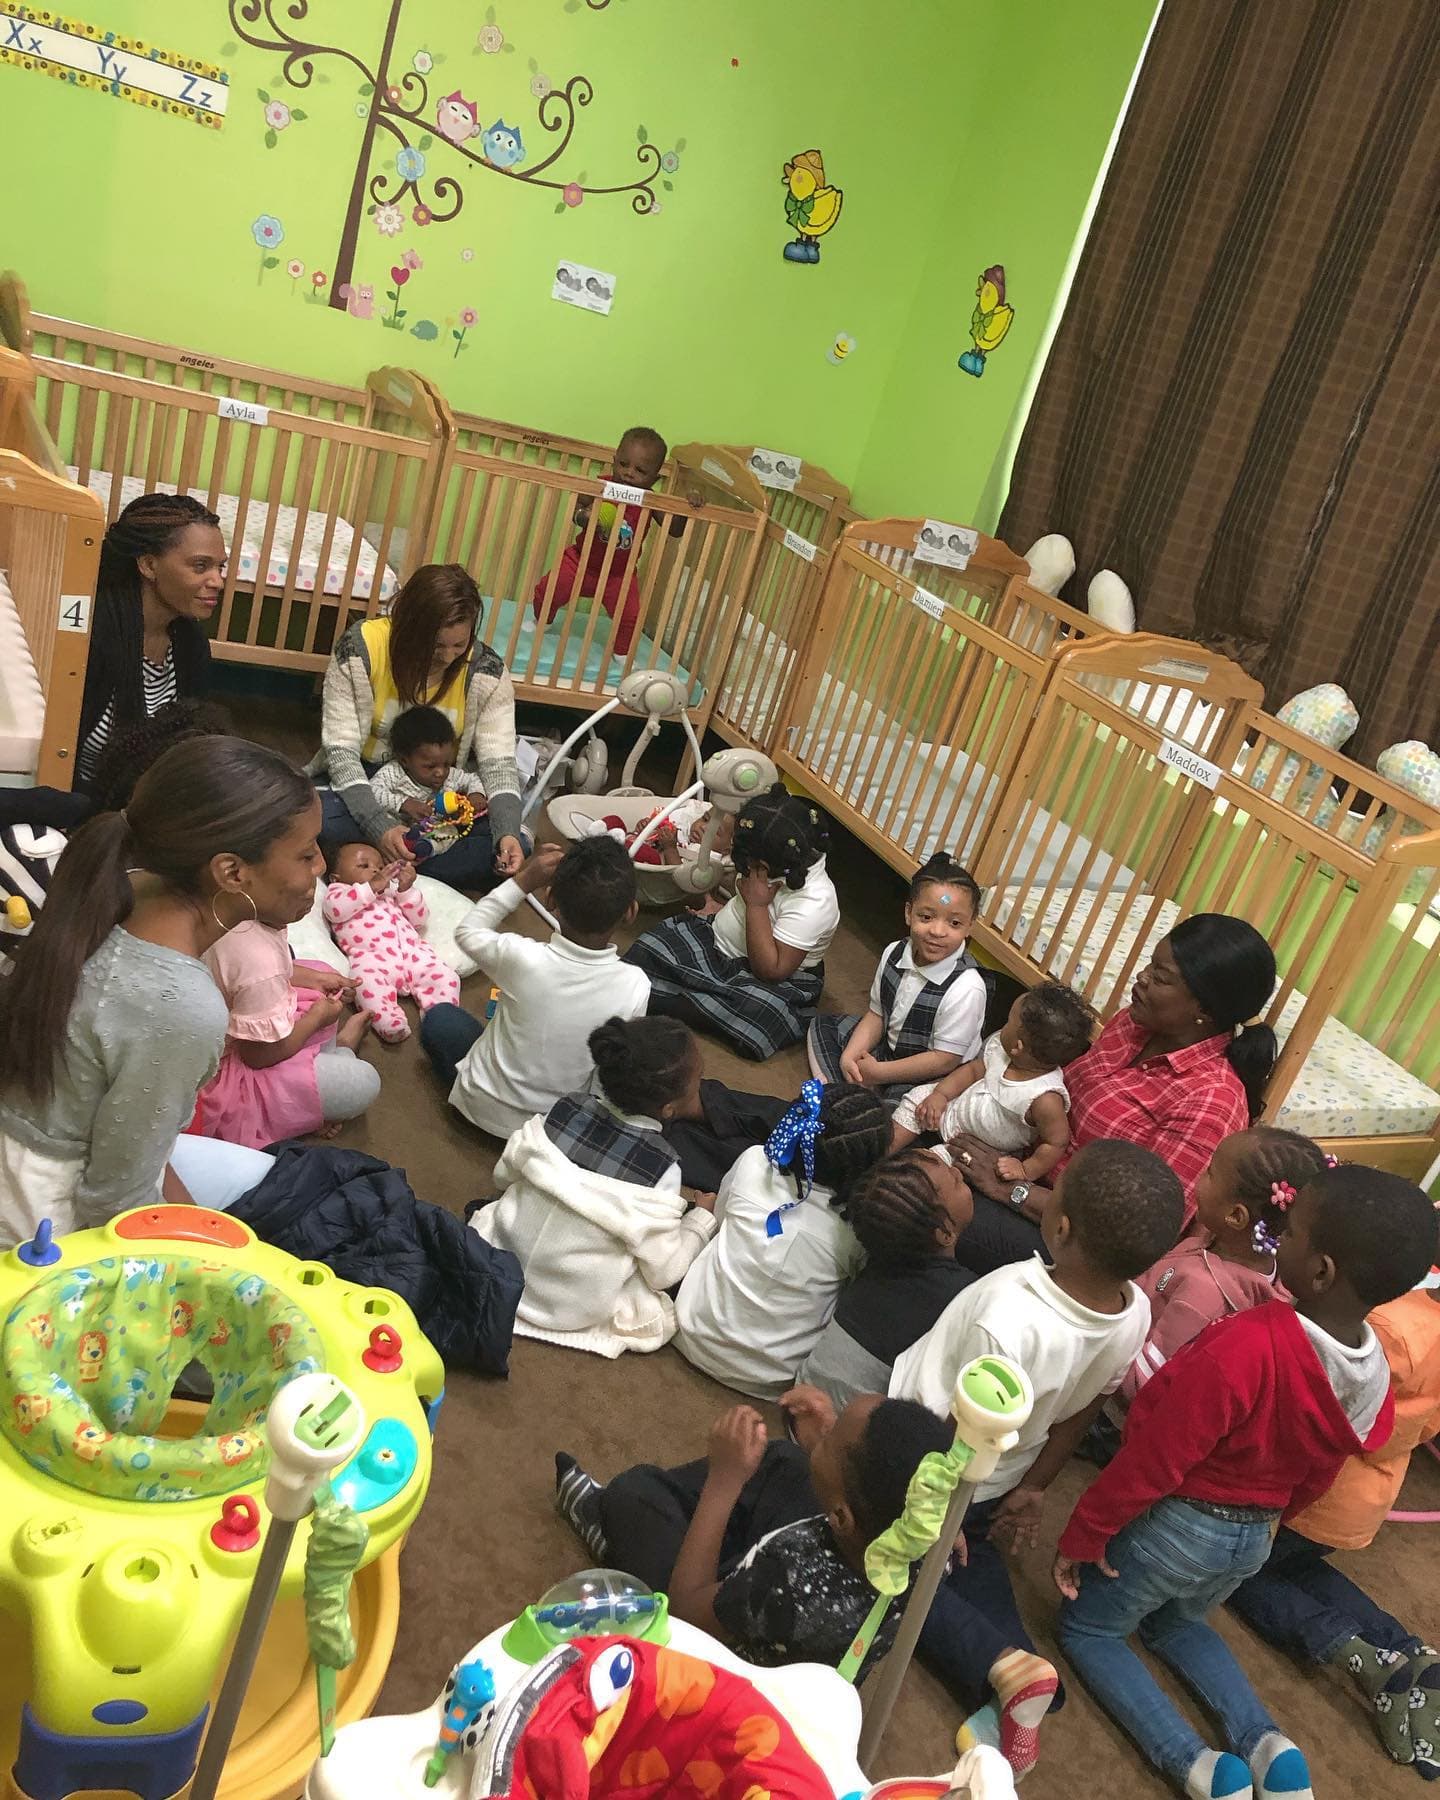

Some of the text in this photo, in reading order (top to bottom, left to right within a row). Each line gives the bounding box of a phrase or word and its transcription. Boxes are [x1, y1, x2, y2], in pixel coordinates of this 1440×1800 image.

[5, 19, 213, 108] Xx Yy Zz
[180, 355, 215, 369] angeles
[226, 403, 256, 419] Ayla
[607, 487, 641, 503] Ayden
[63, 600, 85, 627] 4
[914, 590, 944, 617] Damien
[1165, 746, 1212, 782] Maddox
